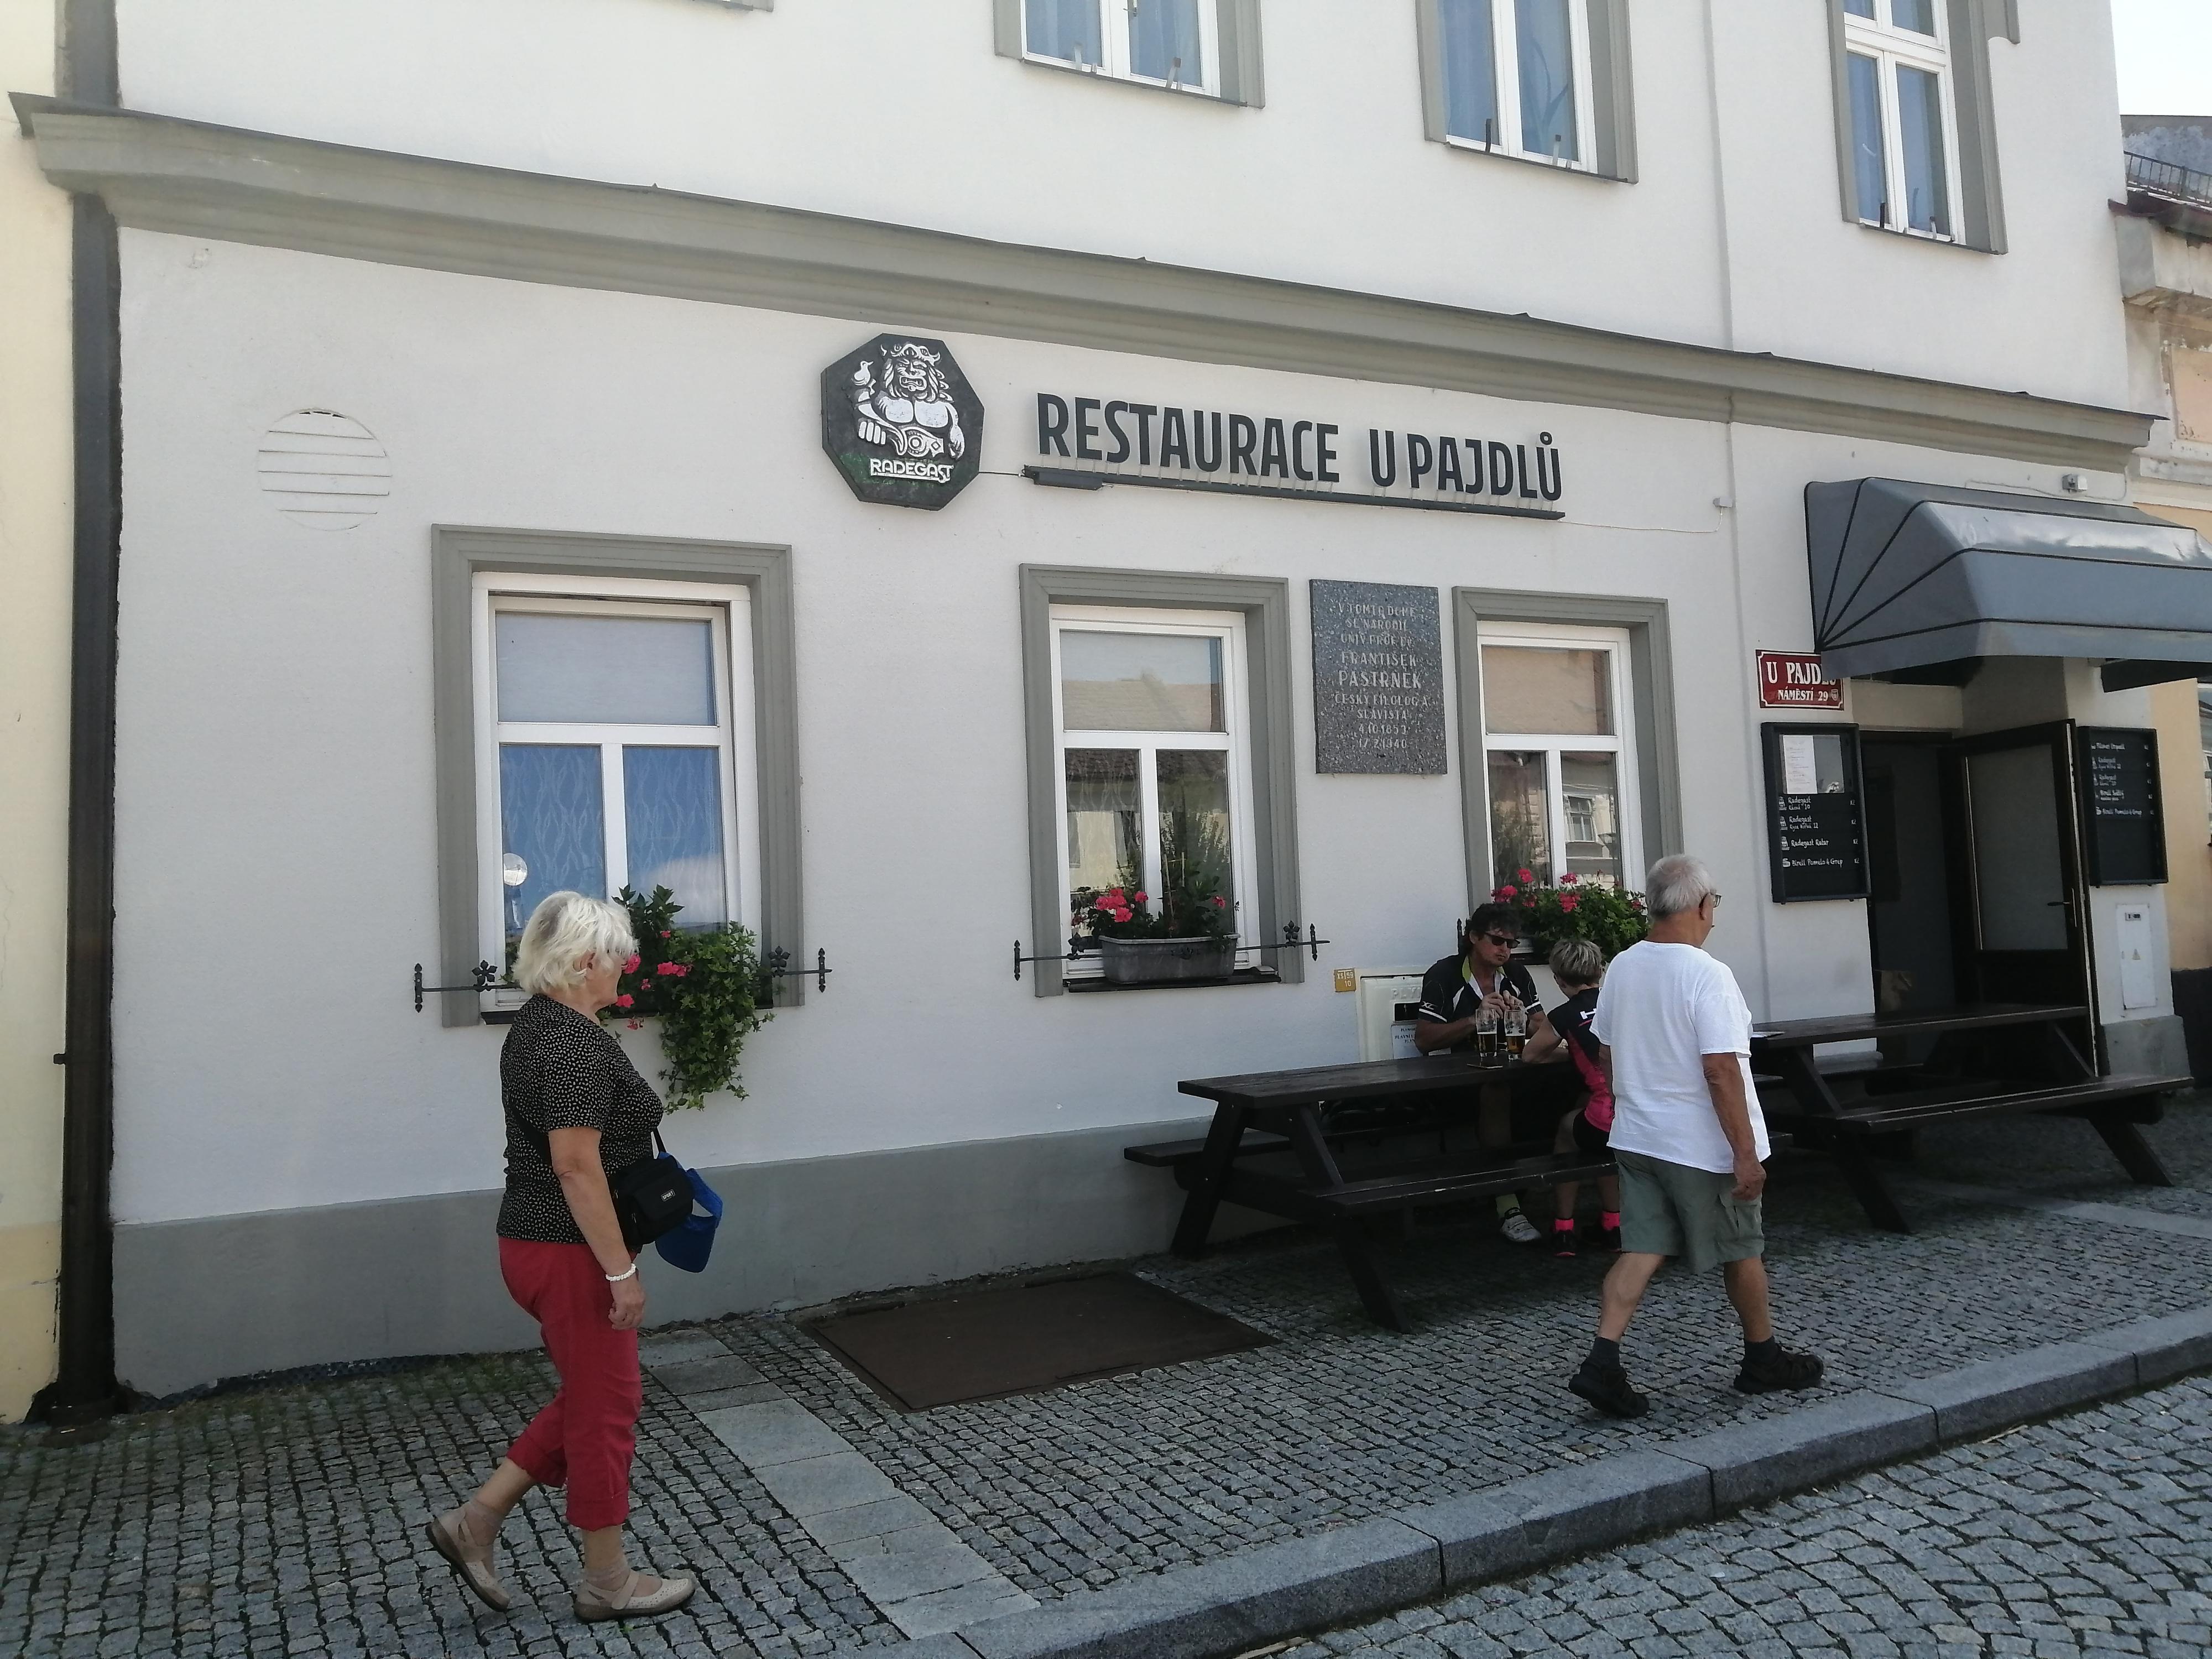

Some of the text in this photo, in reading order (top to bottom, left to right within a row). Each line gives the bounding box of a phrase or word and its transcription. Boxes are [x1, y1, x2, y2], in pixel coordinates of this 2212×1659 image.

[1037, 392, 1562, 501] RESTAURACE U PAJDLŮ
[870, 458, 954, 483] RADEGAST
[1363, 619, 1408, 631] NARODIL
[1339, 670, 1421, 688] PASTRNEK
[1766, 661, 1778, 684] U
[1778, 686, 1829, 701] NÁMĚSTÍ 29
[1357, 709, 1407, 719] SLAVISTA
[1788, 796, 1811, 806] Radegast
[1789, 816, 1812, 825] Radegast
[1791, 838, 1814, 848] Radegast
